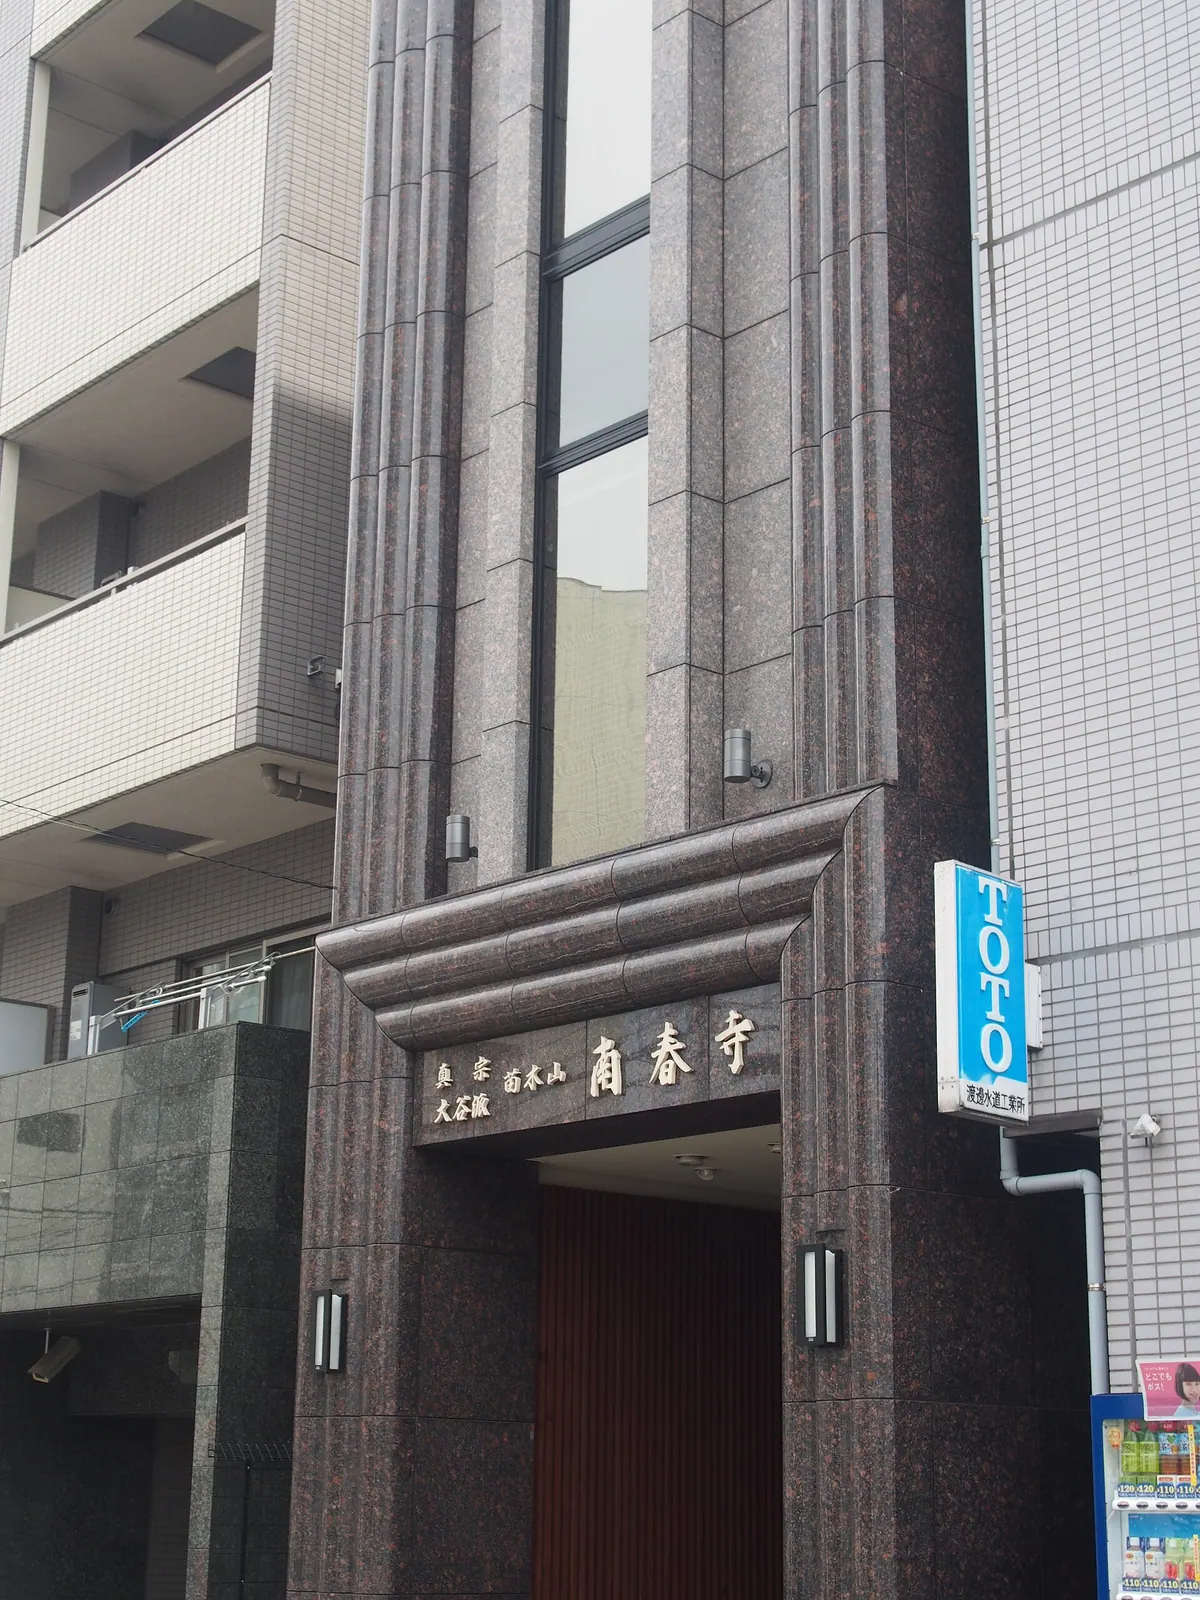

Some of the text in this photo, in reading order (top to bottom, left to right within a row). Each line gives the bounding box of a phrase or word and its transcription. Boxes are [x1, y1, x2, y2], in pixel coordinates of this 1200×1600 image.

[978, 875, 1013, 1073] TOTO
[590, 1009, 756, 1098] 南春寺
[434, 1092, 491, 1124] 大谷派
[1145, 1372, 1172, 1381] どこでも
